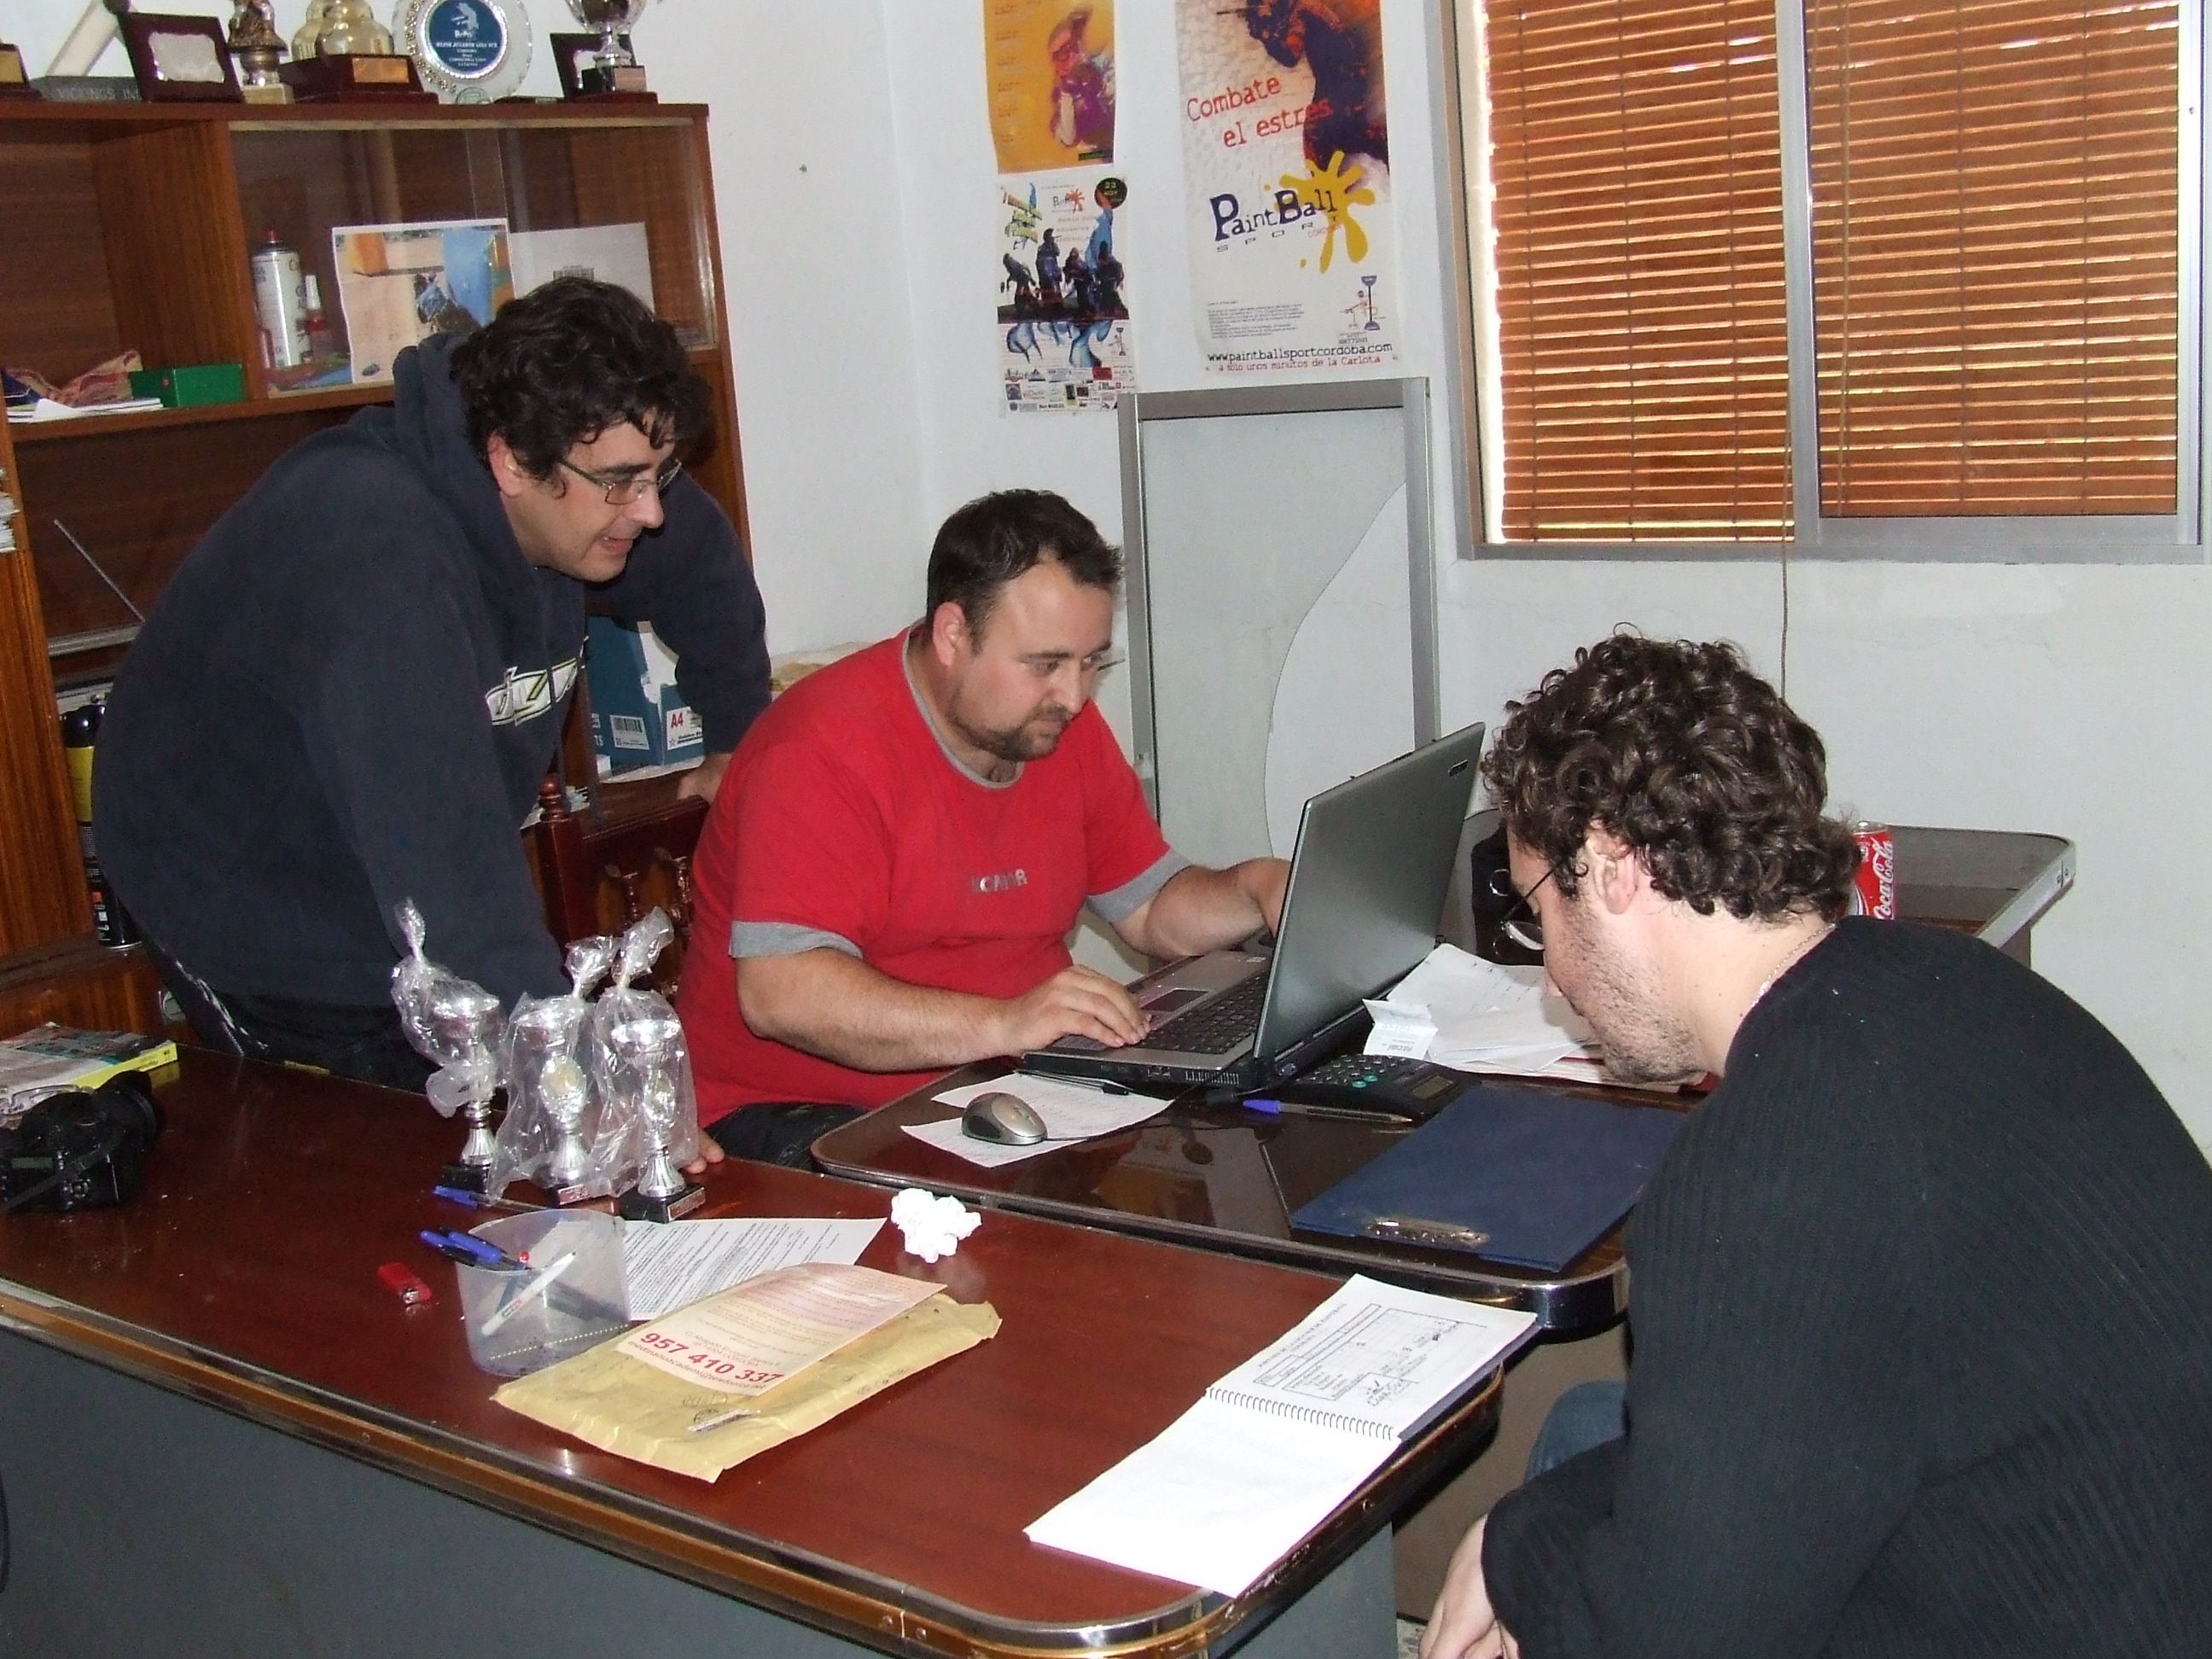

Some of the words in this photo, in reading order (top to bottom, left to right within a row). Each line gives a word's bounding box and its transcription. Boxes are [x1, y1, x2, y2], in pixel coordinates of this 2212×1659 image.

[1187, 77, 1281, 122] Combate
[1223, 121, 1247, 148] el
[1256, 98, 1335, 137] estres
[1209, 189, 1338, 242] PaintBall
[1272, 359, 1308, 370] minutos
[1313, 358, 1324, 367] de
[1328, 358, 1337, 366] la
[1342, 355, 1381, 366] Carlota
[671, 710, 684, 730] A4
[641, 1332, 690, 1353] 957
[688, 1353, 736, 1374] 410
[735, 1369, 784, 1383] 337
